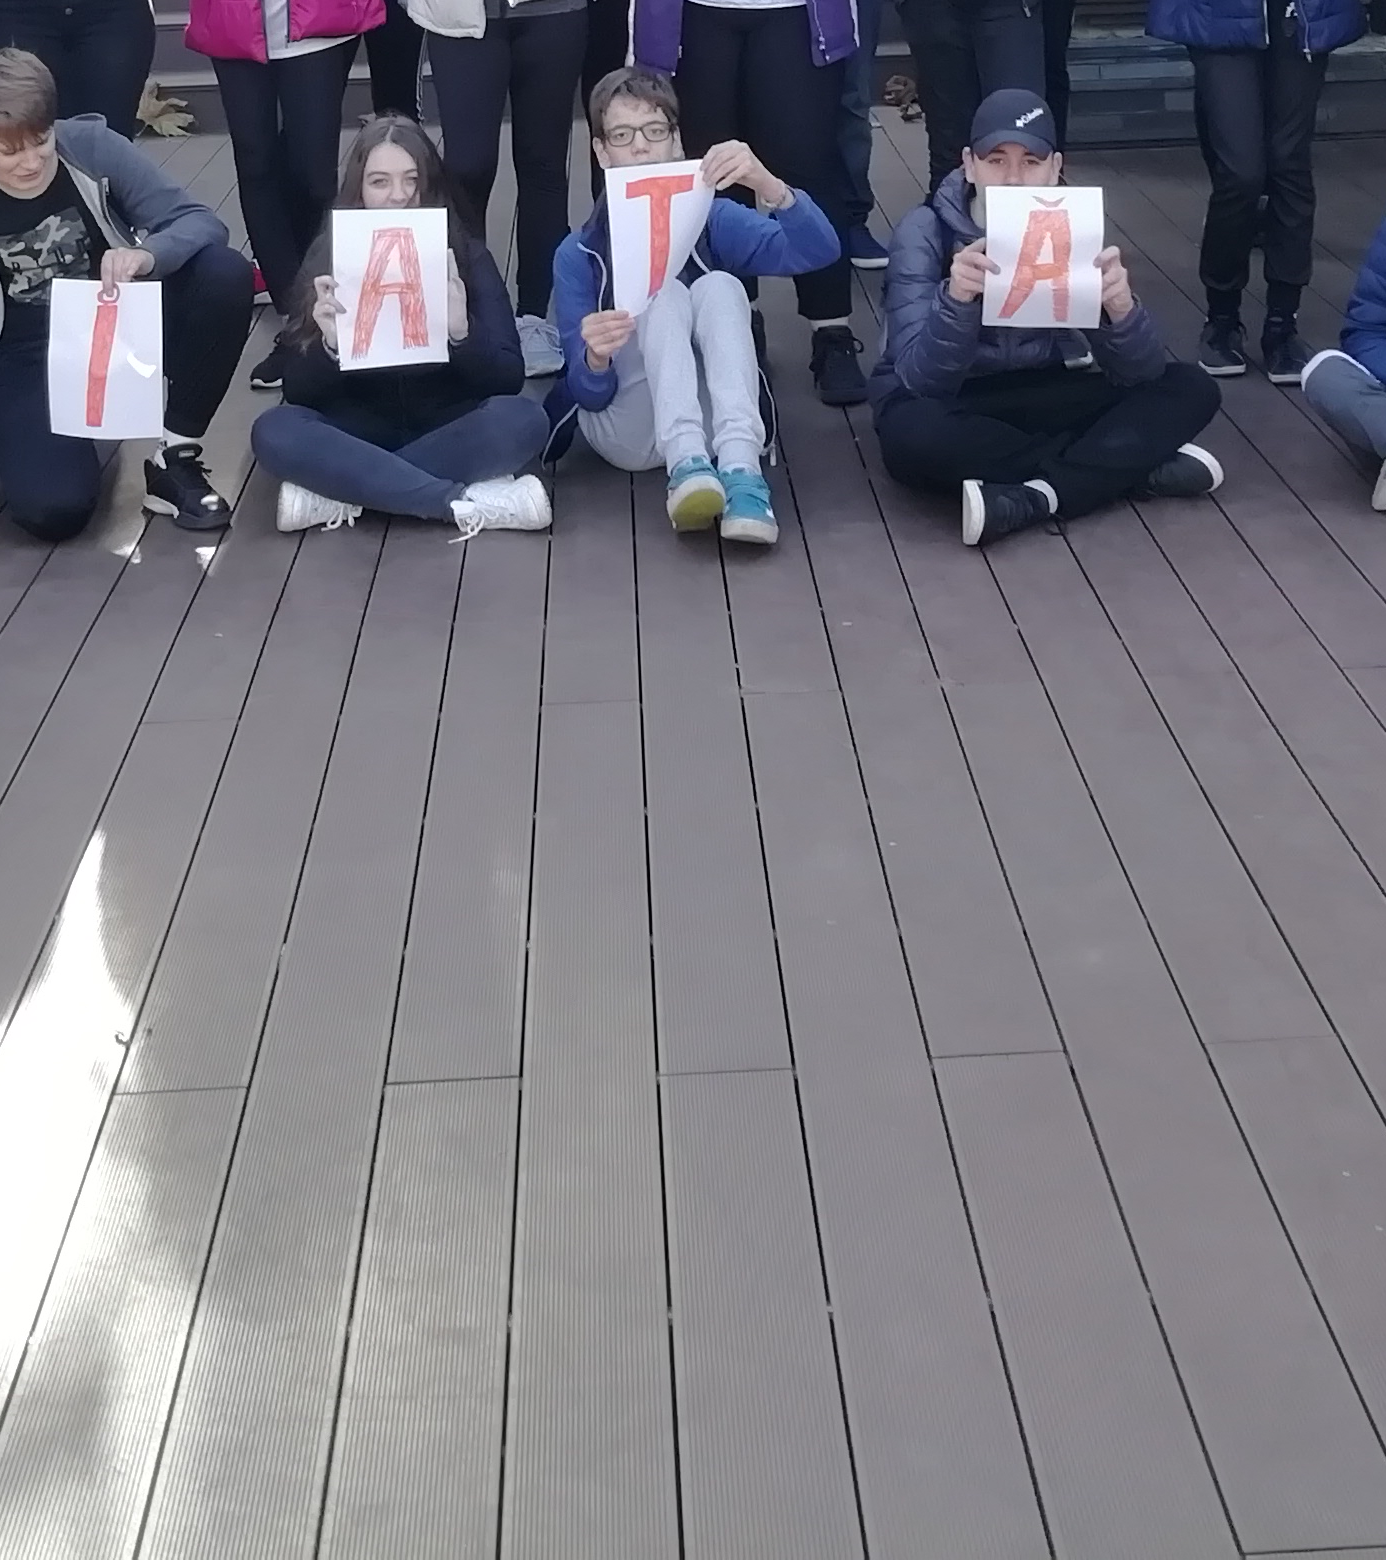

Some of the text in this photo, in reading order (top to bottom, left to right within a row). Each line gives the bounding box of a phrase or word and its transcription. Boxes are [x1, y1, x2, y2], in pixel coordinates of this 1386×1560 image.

[349, 227, 430, 360] A
[625, 172, 696, 301] T
[997, 194, 1072, 324] Ă
